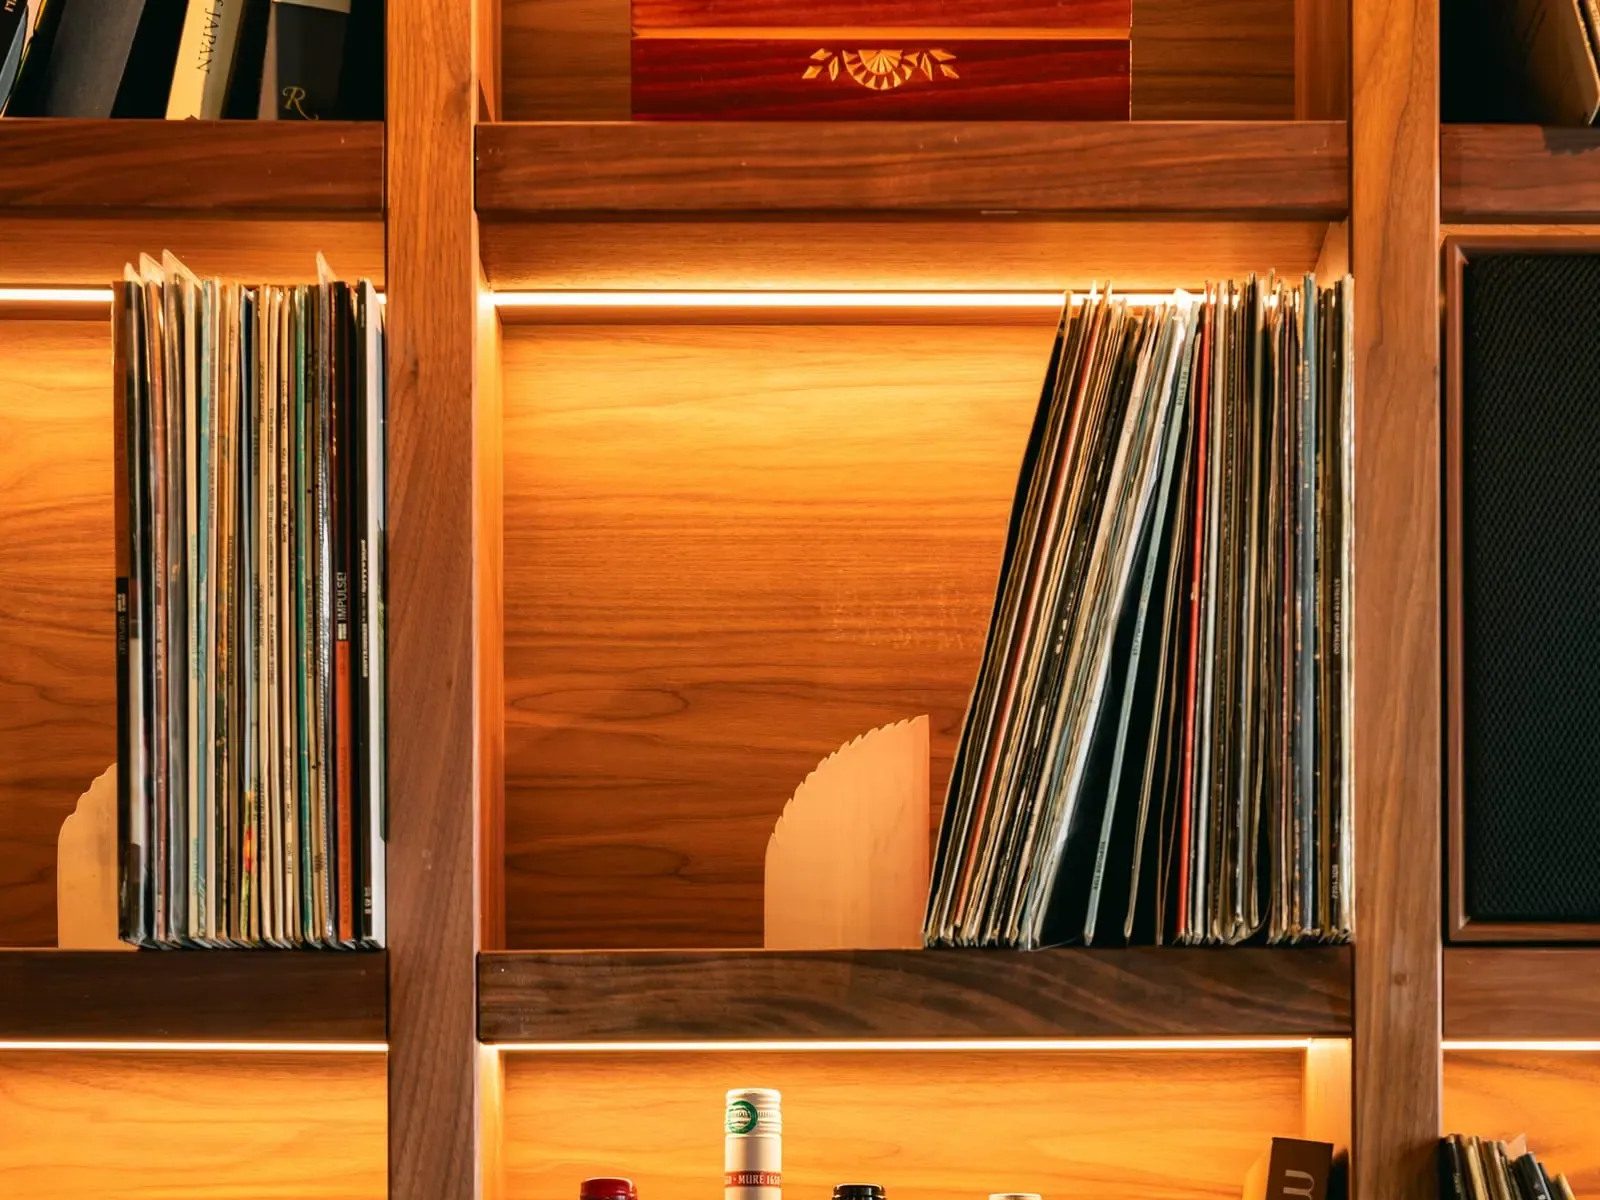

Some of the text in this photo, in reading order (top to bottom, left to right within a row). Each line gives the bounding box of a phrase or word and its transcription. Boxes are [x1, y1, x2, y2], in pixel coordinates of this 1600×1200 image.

[196, 8, 221, 74] JAPAN
[282, 85, 319, 121] R
[336, 572, 347, 621] IMPULSE!
[738, 1172, 765, 1185] MURÉ
